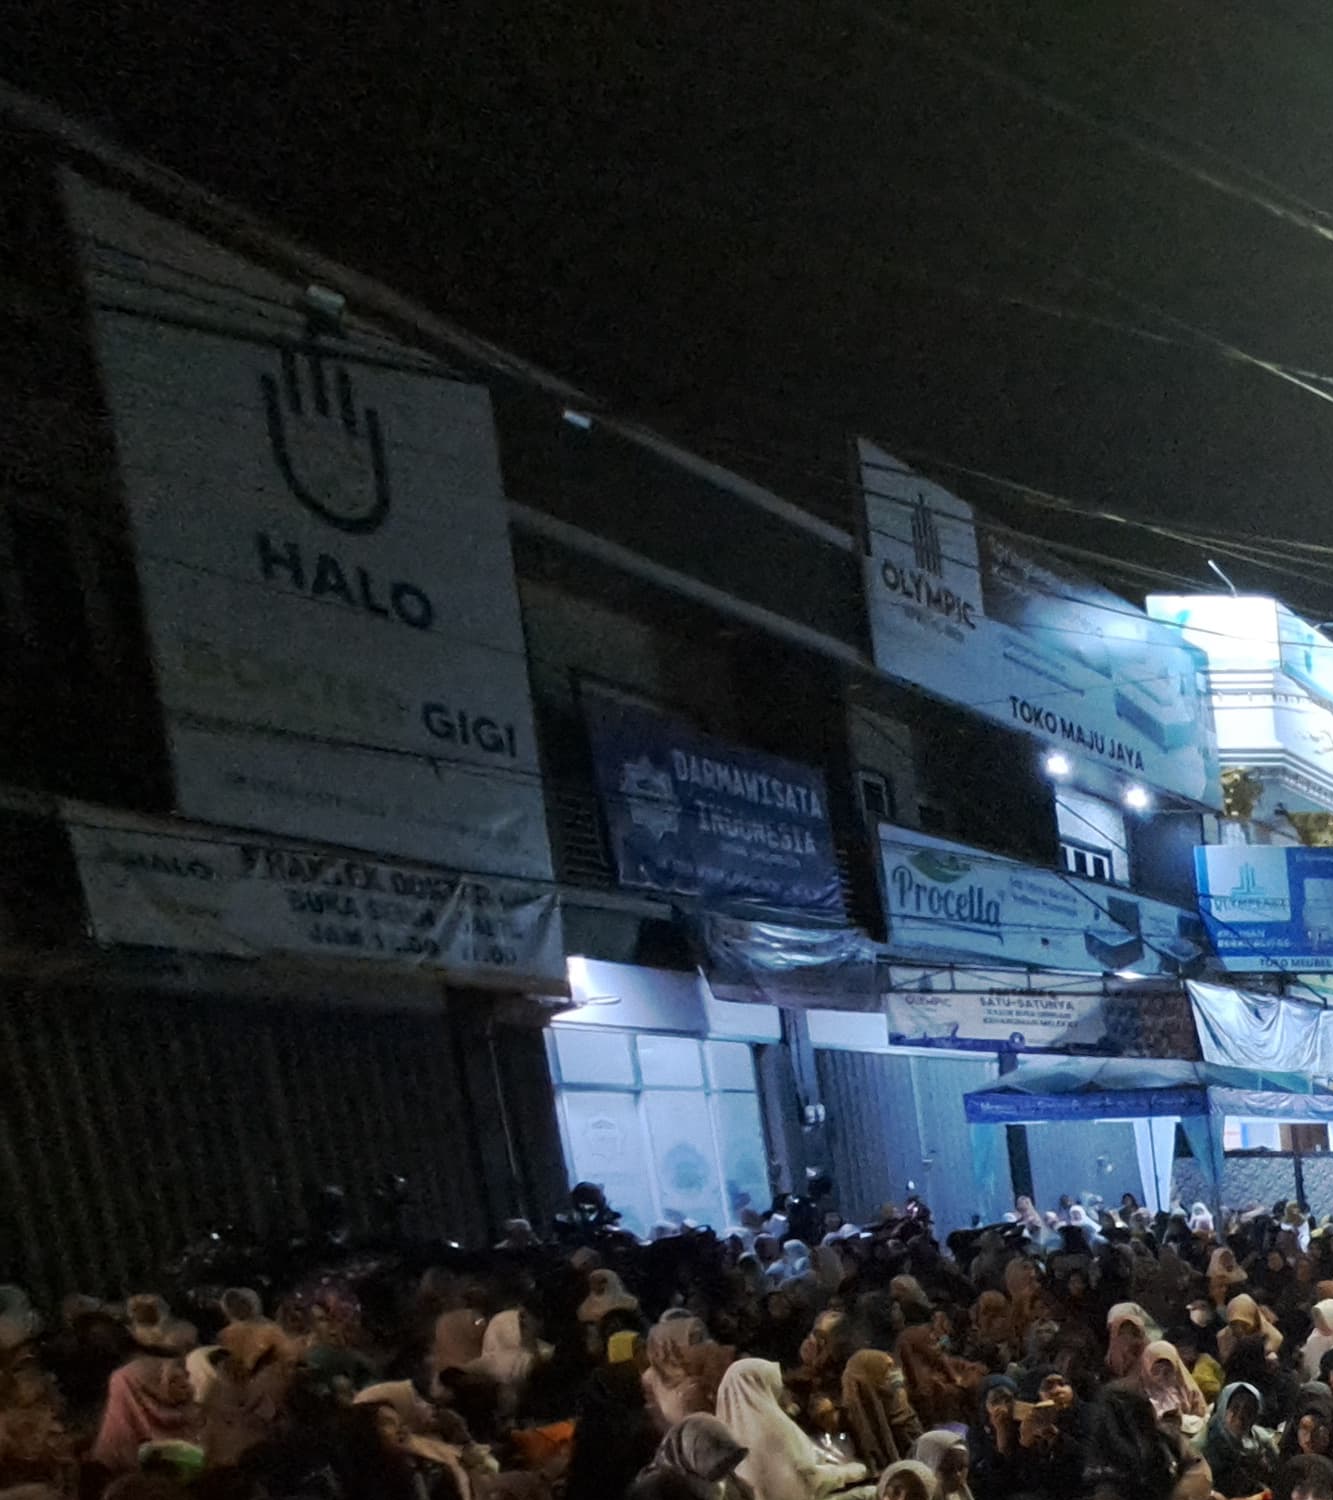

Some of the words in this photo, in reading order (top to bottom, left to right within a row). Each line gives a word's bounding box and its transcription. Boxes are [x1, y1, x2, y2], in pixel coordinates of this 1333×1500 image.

[256, 531, 435, 632] HALO
[881, 557, 977, 630] OLYMPIC
[421, 700, 519, 758] GIGI
[1009, 694, 1058, 736] TOKO
[1060, 718, 1105, 755] MAJU
[1109, 738, 1145, 772] JAYA
[670, 748, 823, 820] DARMAWISATA
[892, 863, 1002, 928] Procella
